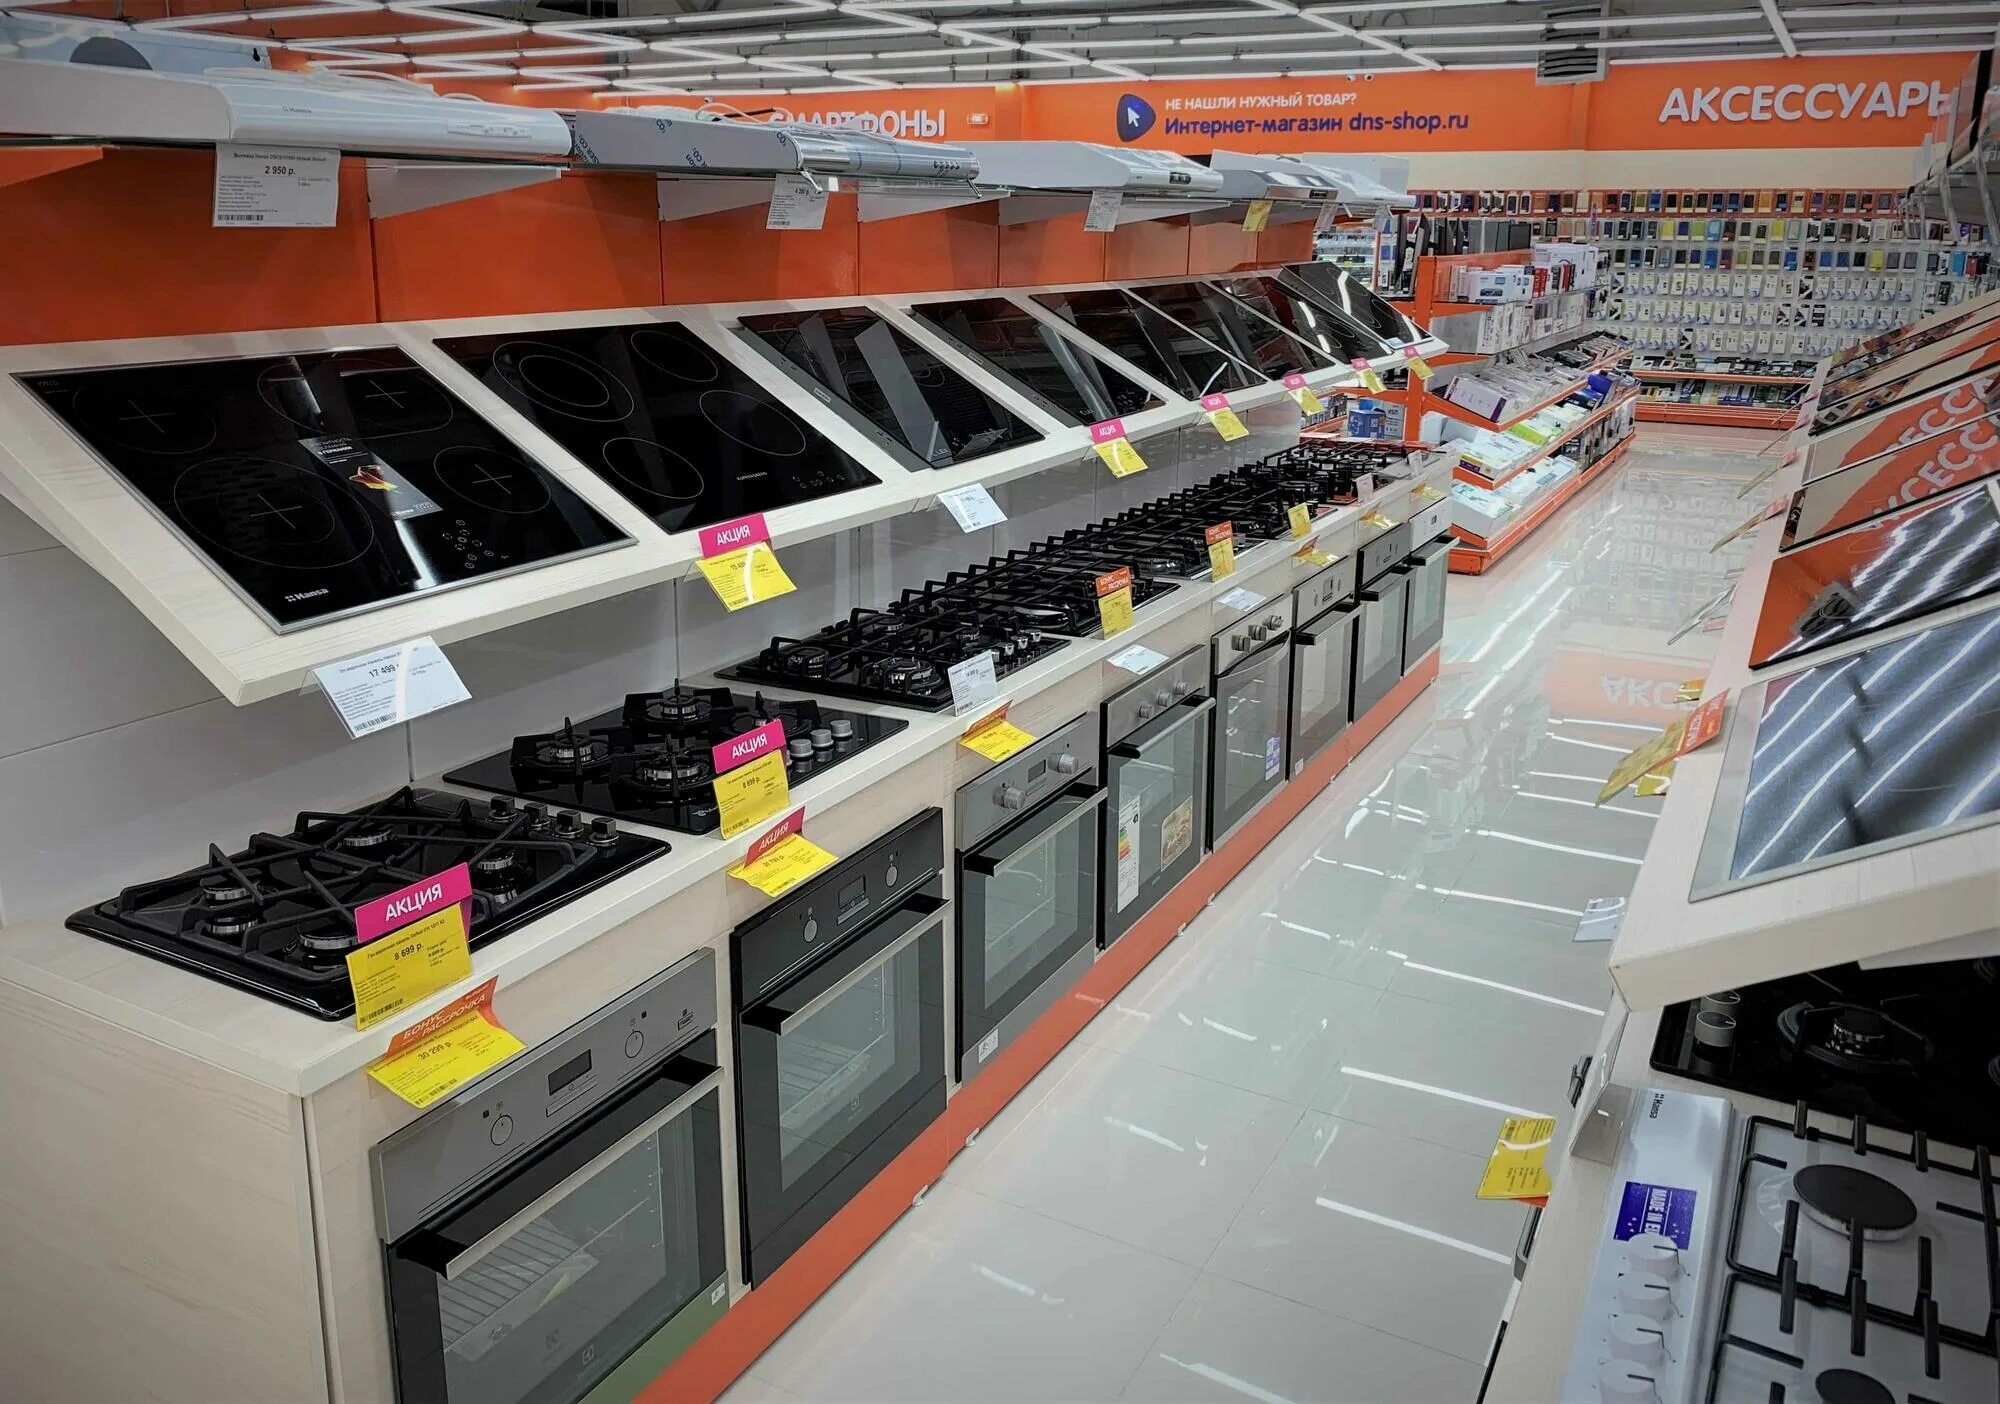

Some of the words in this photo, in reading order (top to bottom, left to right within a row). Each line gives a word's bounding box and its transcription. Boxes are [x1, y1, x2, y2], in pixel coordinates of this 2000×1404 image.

[1165, 98, 1182, 111] НЕ
[1184, 96, 1237, 110] НАШЛИ
[1239, 91, 1303, 109] НУЖНЫЙ
[1306, 92, 1357, 107] ТОВАР?
[1164, 116, 1343, 138] Интернет-магазин
[1349, 110, 1470, 136] dns-shop.ru
[264, 165, 270, 175] 2
[272, 165, 287, 175] 950
[716, 524, 751, 546] АКЦИЯ
[369, 668, 379, 678] 17
[381, 664, 396, 675] 499
[732, 733, 768, 759] АКЦИЯ
[758, 821, 790, 852] АКЦИЯ
[385, 882, 443, 922] АКЦИЯ
[394, 952, 400, 961] 8
[401, 945, 415, 957] 699
[403, 1008, 446, 1040] БОНУС
[422, 993, 487, 1038] РАССРОЧКА
[1650, 1098, 1663, 1119] Hansa
[1649, 1187, 1667, 1212] MADE
[1647, 1212, 1662, 1223] IN
